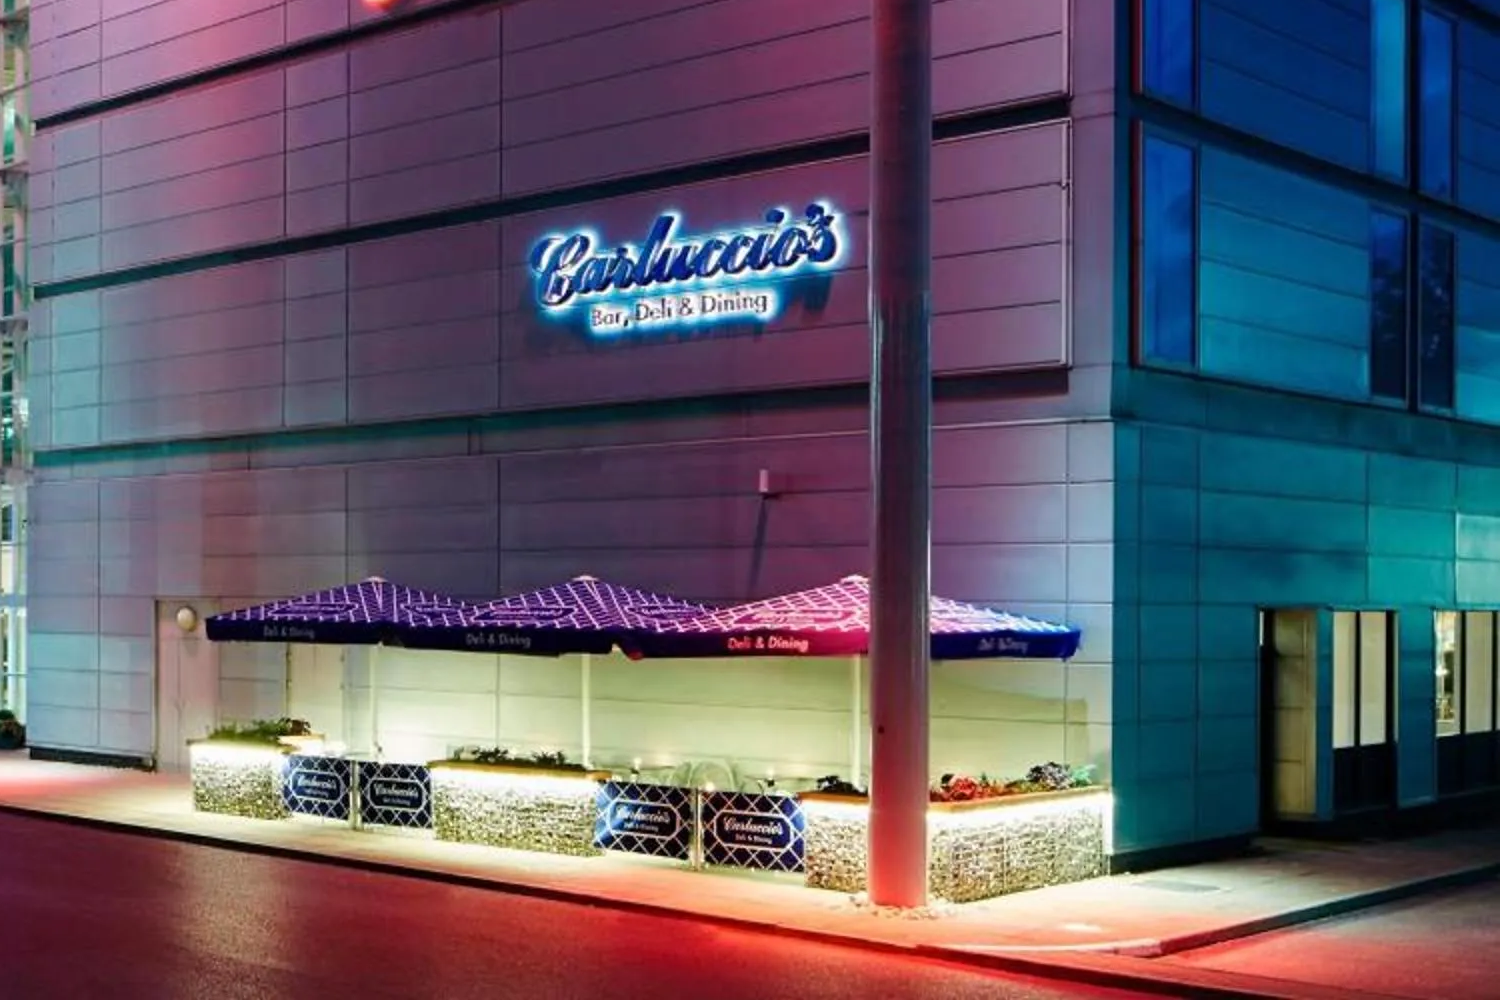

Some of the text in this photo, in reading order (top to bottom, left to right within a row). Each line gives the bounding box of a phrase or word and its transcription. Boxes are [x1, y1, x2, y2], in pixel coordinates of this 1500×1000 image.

[530, 203, 837, 306] Carluccio's
[591, 291, 769, 327] Bar, Deli & Dining
[755, 636, 765, 650] &
[768, 635, 809, 652] Dining
